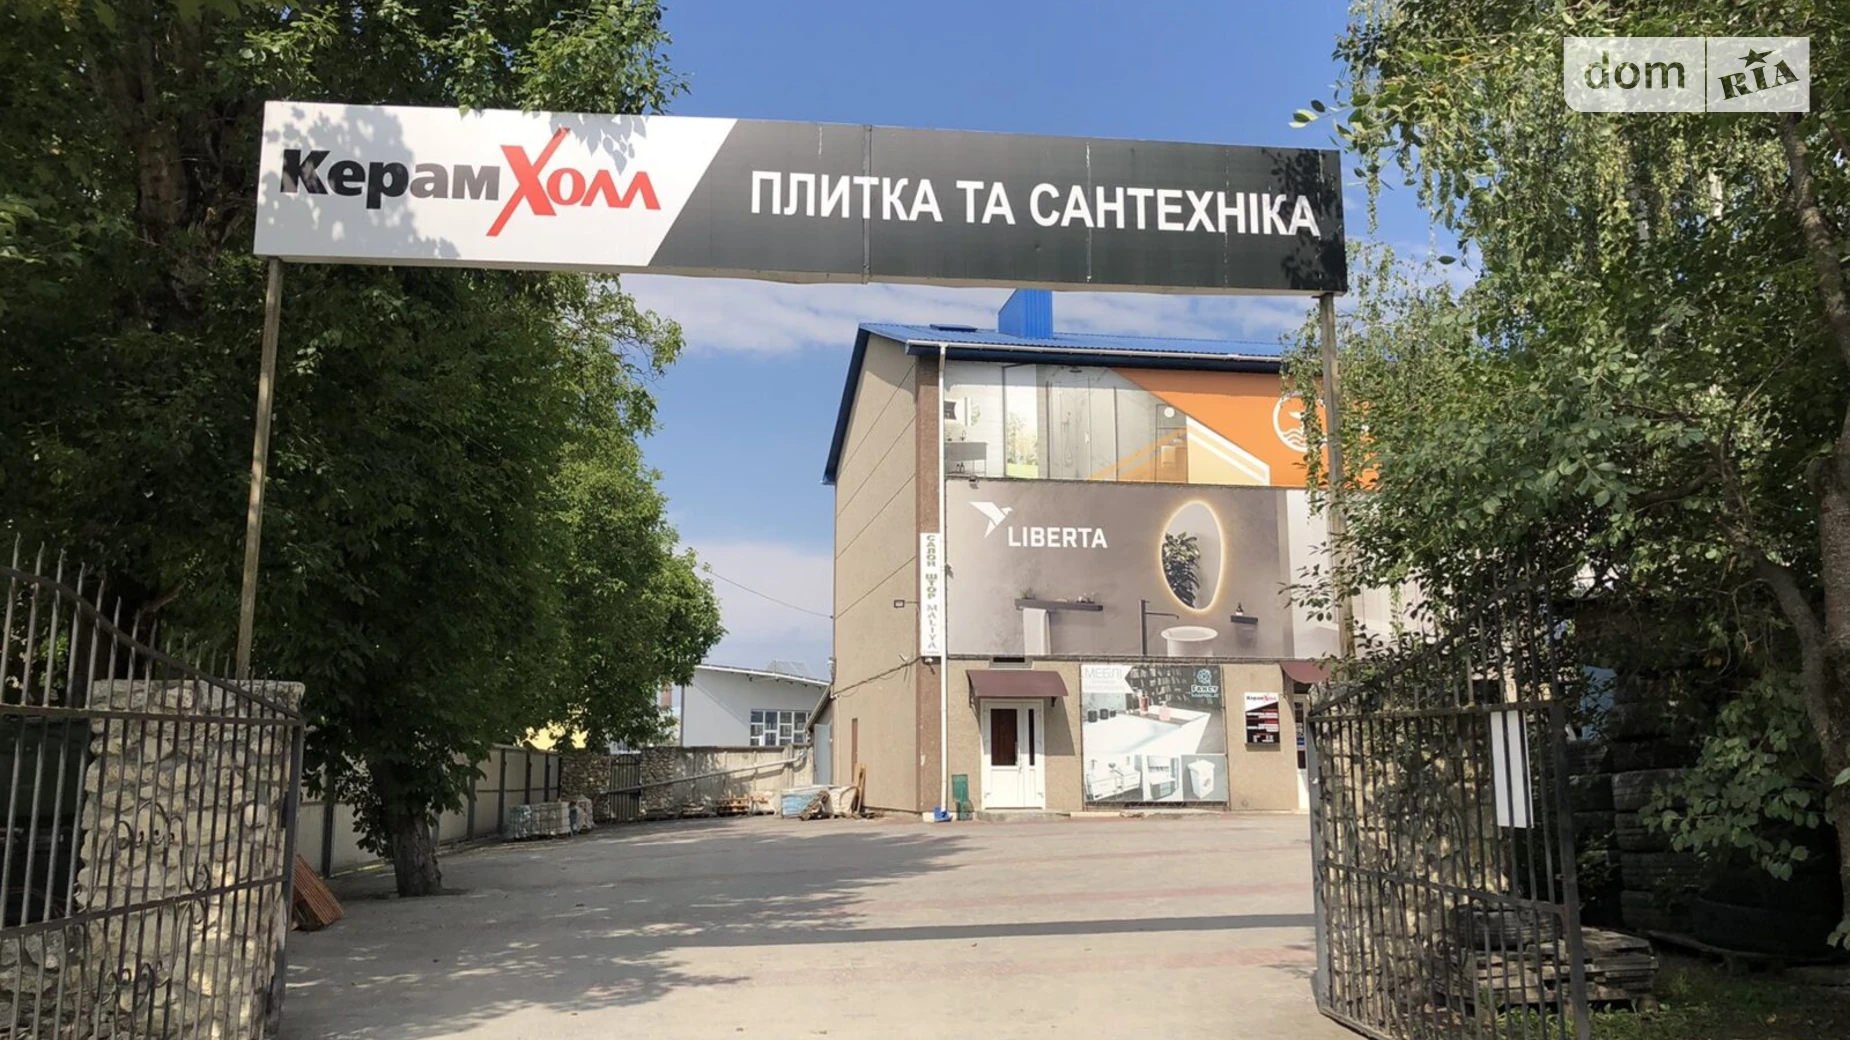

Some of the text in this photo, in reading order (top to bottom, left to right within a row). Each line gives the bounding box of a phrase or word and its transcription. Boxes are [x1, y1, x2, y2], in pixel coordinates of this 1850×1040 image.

[750, 170, 1321, 237] ПЛИТКА ТА САНТЕХНІКА
[925, 534, 938, 600] САЛОН ШТОР
[1008, 526, 1109, 549] LIBERTA
